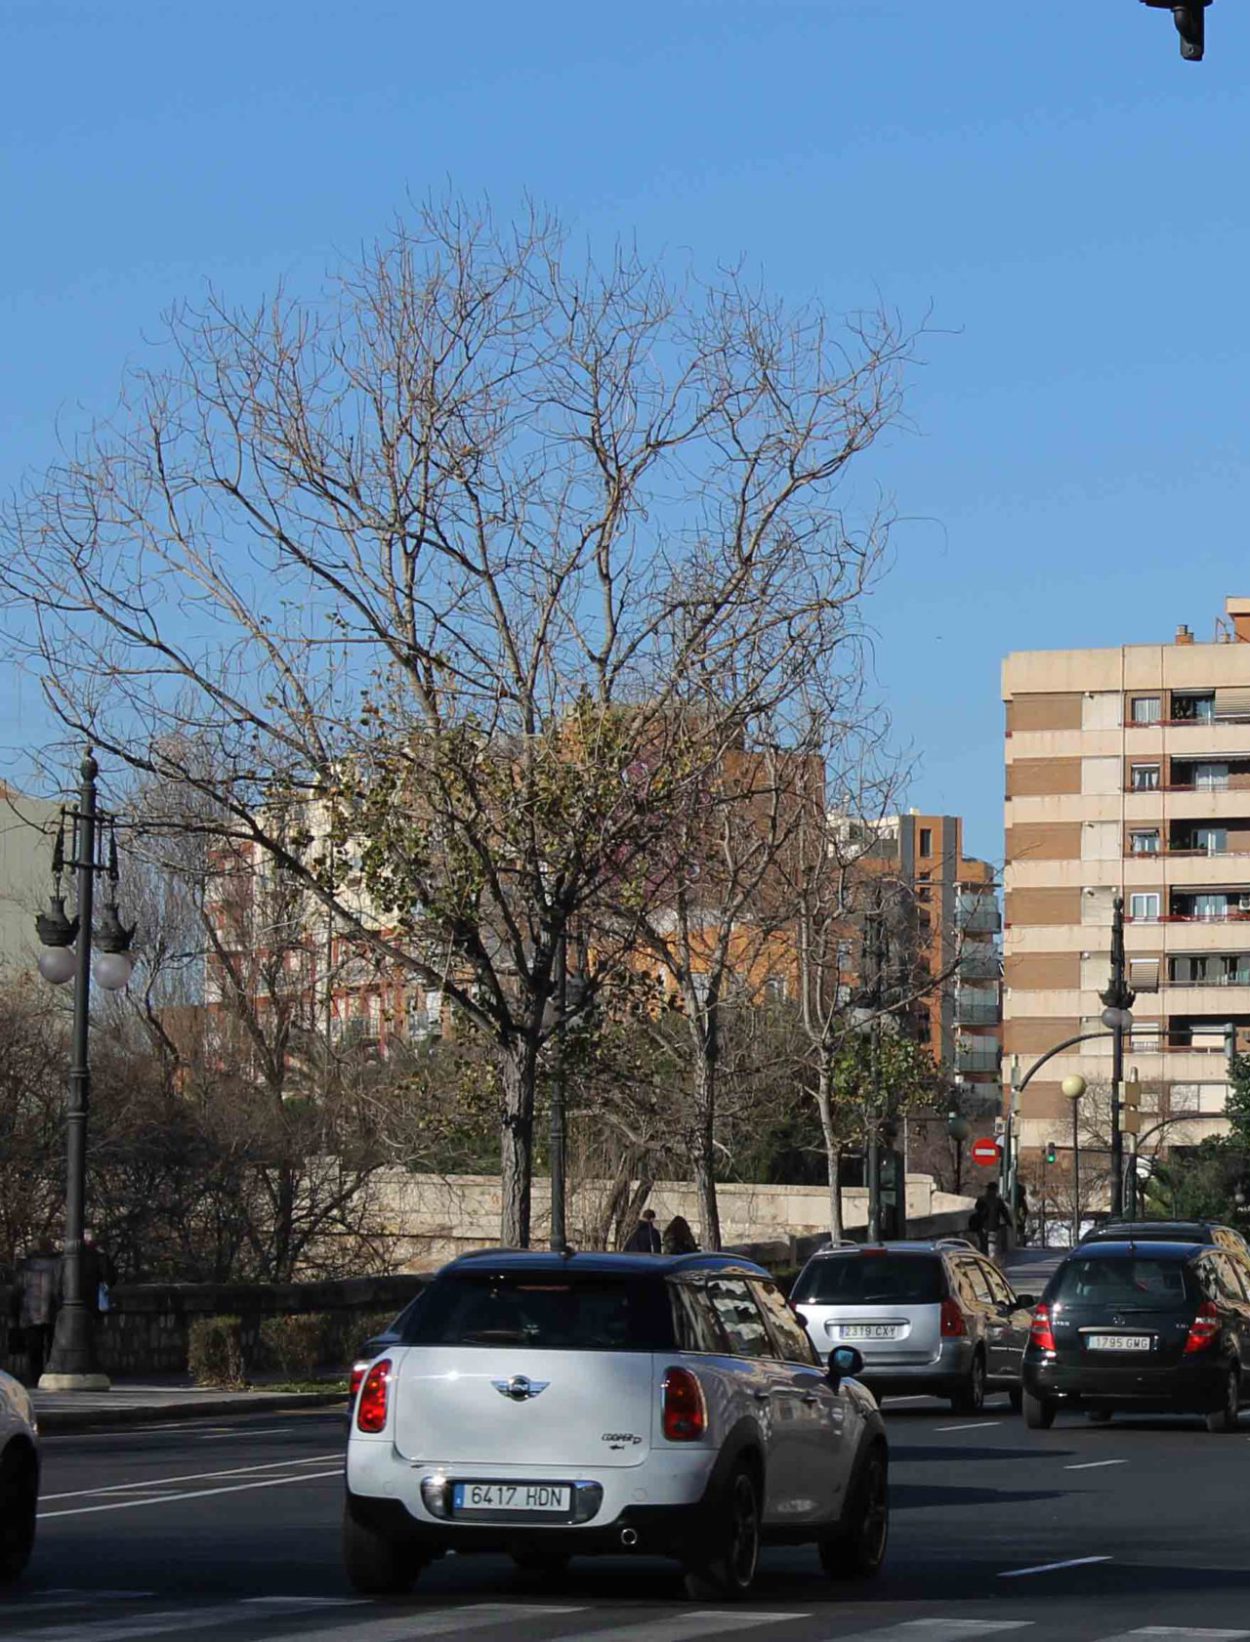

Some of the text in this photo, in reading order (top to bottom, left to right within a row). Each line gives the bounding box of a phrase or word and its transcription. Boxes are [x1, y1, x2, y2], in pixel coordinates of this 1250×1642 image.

[875, 1327, 896, 1336] CXY
[1096, 1337, 1123, 1347] 1795
[601, 1432, 634, 1442] COOPER
[470, 1486, 562, 1507] 6417 HDN
